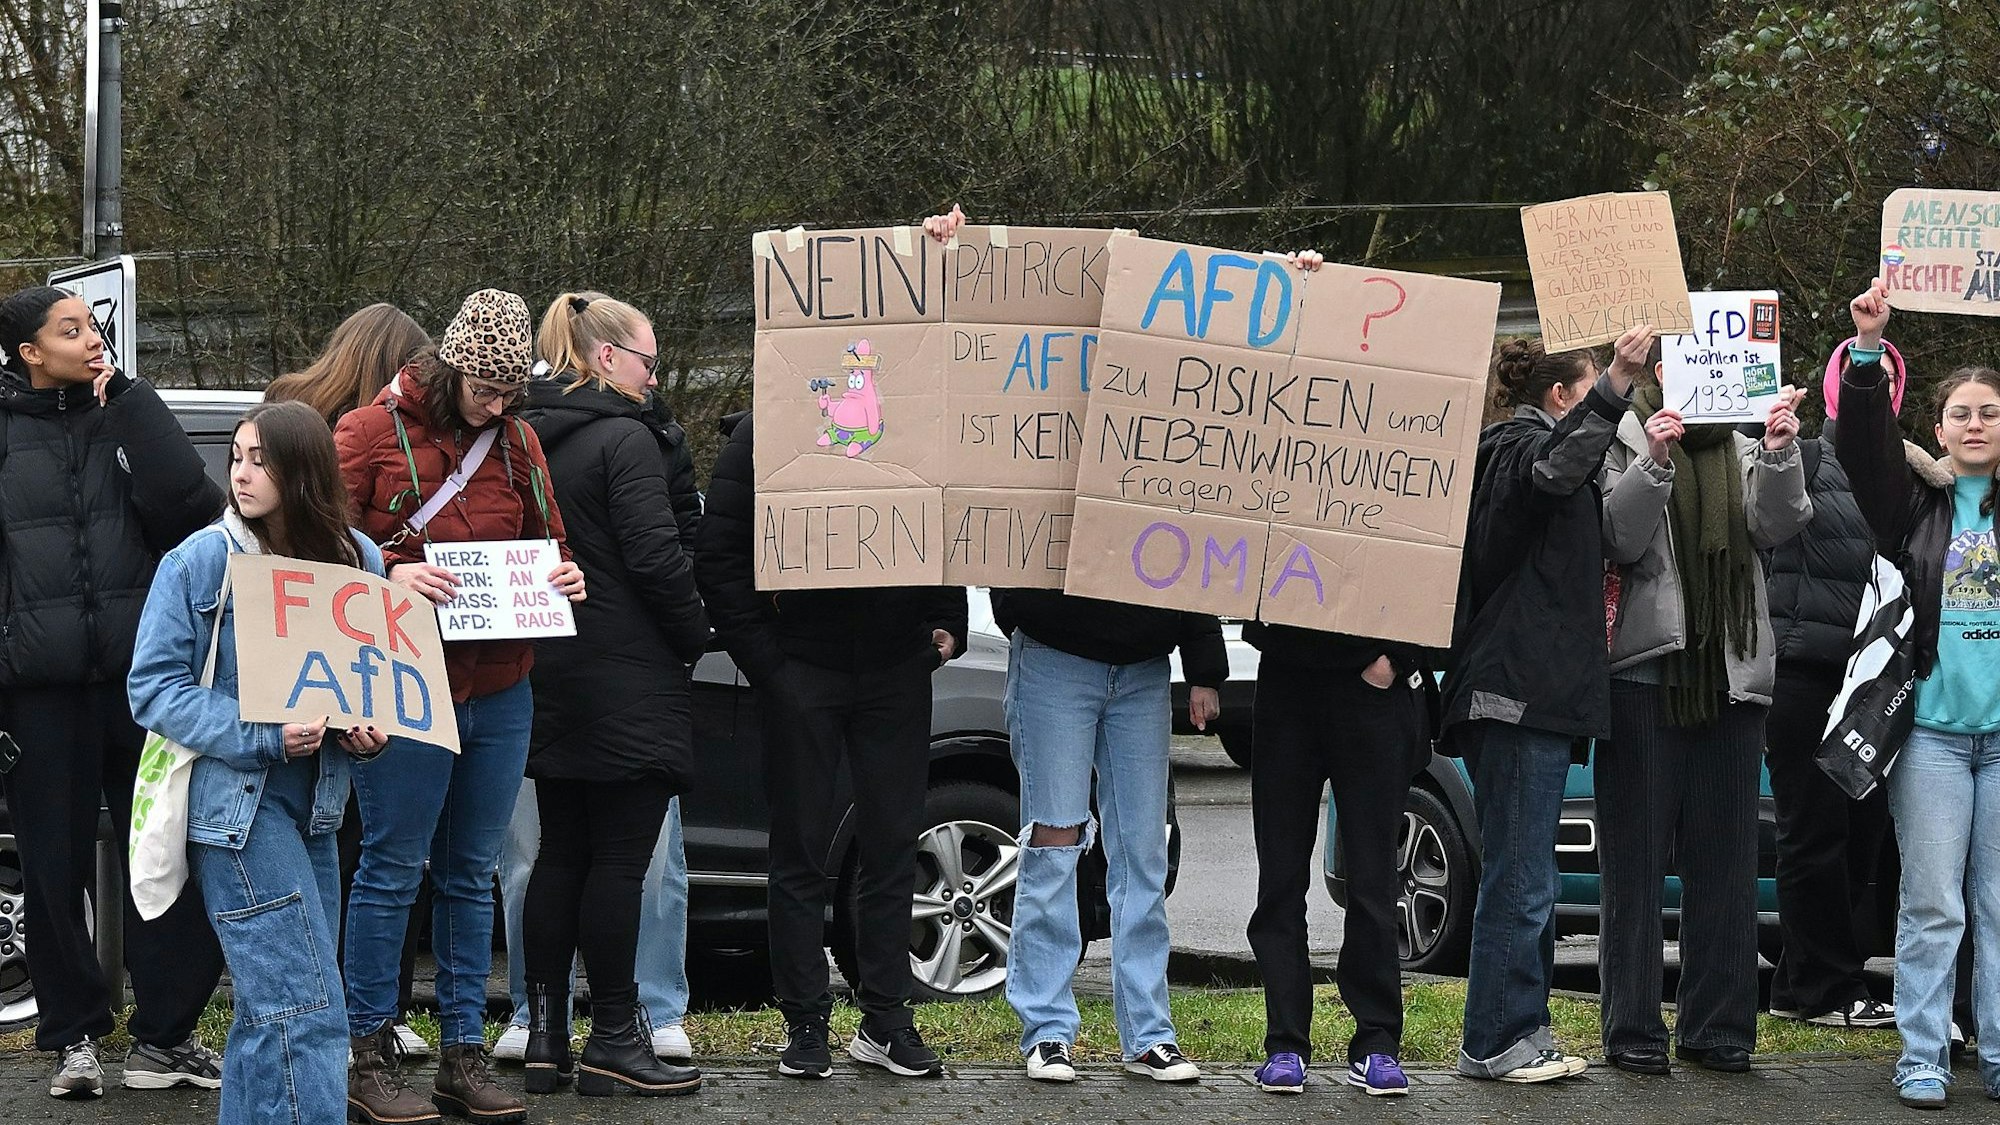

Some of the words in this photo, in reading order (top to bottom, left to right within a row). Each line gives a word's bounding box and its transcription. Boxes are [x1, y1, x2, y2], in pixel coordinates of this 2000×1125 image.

[1532, 206, 1580, 233] WER
[1587, 200, 1655, 224] NICHT
[1553, 225, 1618, 248] DENKT
[1630, 222, 1664, 233] UND
[1897, 226, 1981, 249] RECHTE
[1539, 249, 1584, 268] WER
[1593, 238, 1656, 255] NICHTS
[765, 235, 926, 320] NEIN
[955, 240, 1105, 304] PATRICK
[1548, 271, 1613, 298] GLAUBT
[1619, 269, 1651, 287] DEN
[1886, 263, 1964, 293] RECHTE
[1140, 249, 1293, 349] AFD
[1565, 287, 1655, 314] GANZEN
[954, 330, 998, 362] DIE
[1743, 350, 1761, 365] ist
[1709, 369, 1723, 379] so
[1172, 356, 1375, 434] RISIKEN
[1389, 400, 1450, 438] und
[1679, 383, 1749, 414] 1933
[959, 413, 1000, 446] IST
[1099, 413, 1456, 499] NEBENWIRKUNGEN
[1118, 465, 1232, 515] fragen
[1242, 478, 1290, 514] Sie
[1316, 488, 1384, 530] Ihre
[435, 551, 490, 567] HERZ:
[505, 549, 540, 565] AUF
[1131, 521, 1325, 605] OMA
[509, 570, 533, 587] AN
[272, 569, 422, 660] FCK
[513, 591, 550, 608] AUS
[449, 614, 492, 630] AFD:
[515, 612, 565, 629] RAUS
[1962, 629, 2000, 639] adida
[285, 644, 434, 732] AfD
